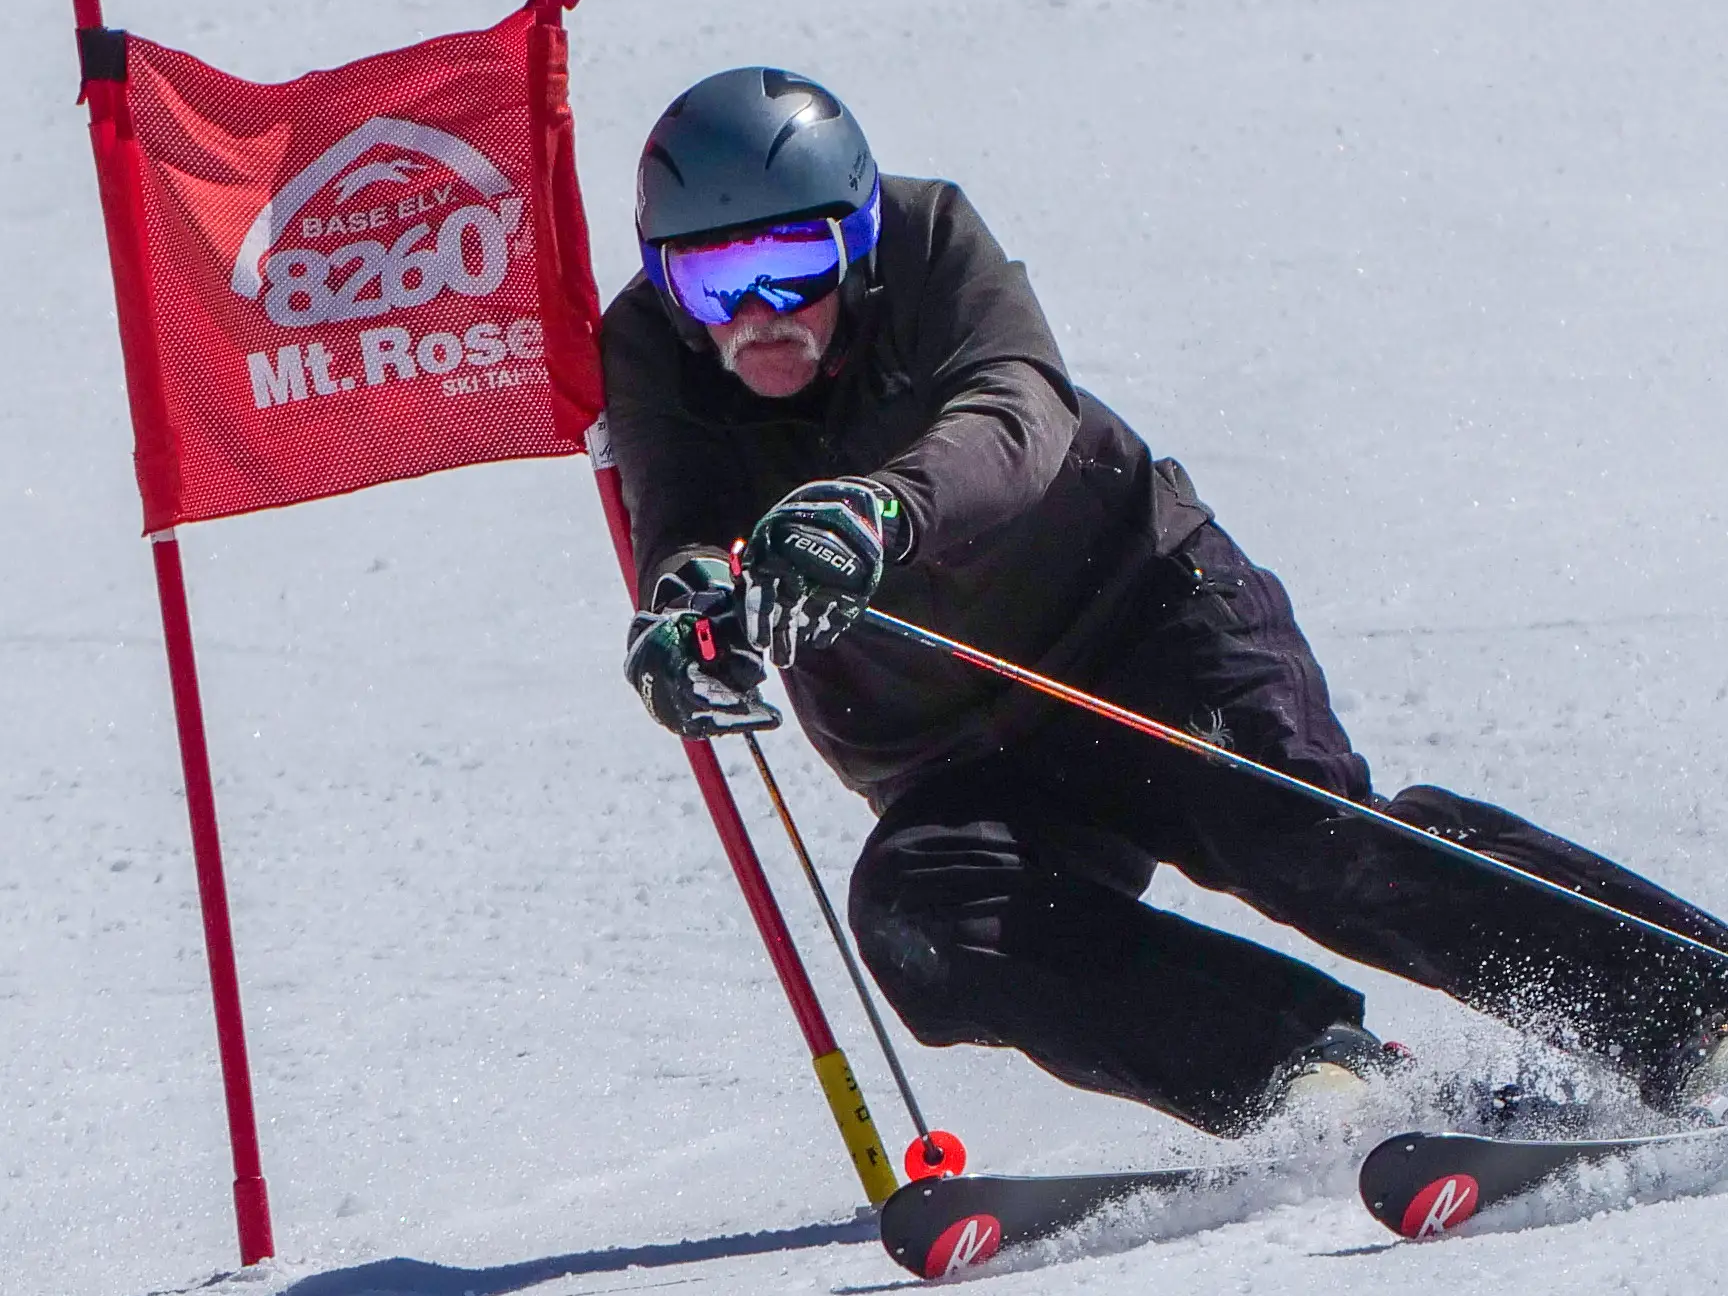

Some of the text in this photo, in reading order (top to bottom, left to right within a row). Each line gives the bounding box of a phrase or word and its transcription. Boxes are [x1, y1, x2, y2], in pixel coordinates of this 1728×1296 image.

[301, 205, 389, 238] BASE
[247, 318, 544, 409] Mt. Rose
[441, 375, 479, 397] SKI
[784, 533, 857, 576] reusch
